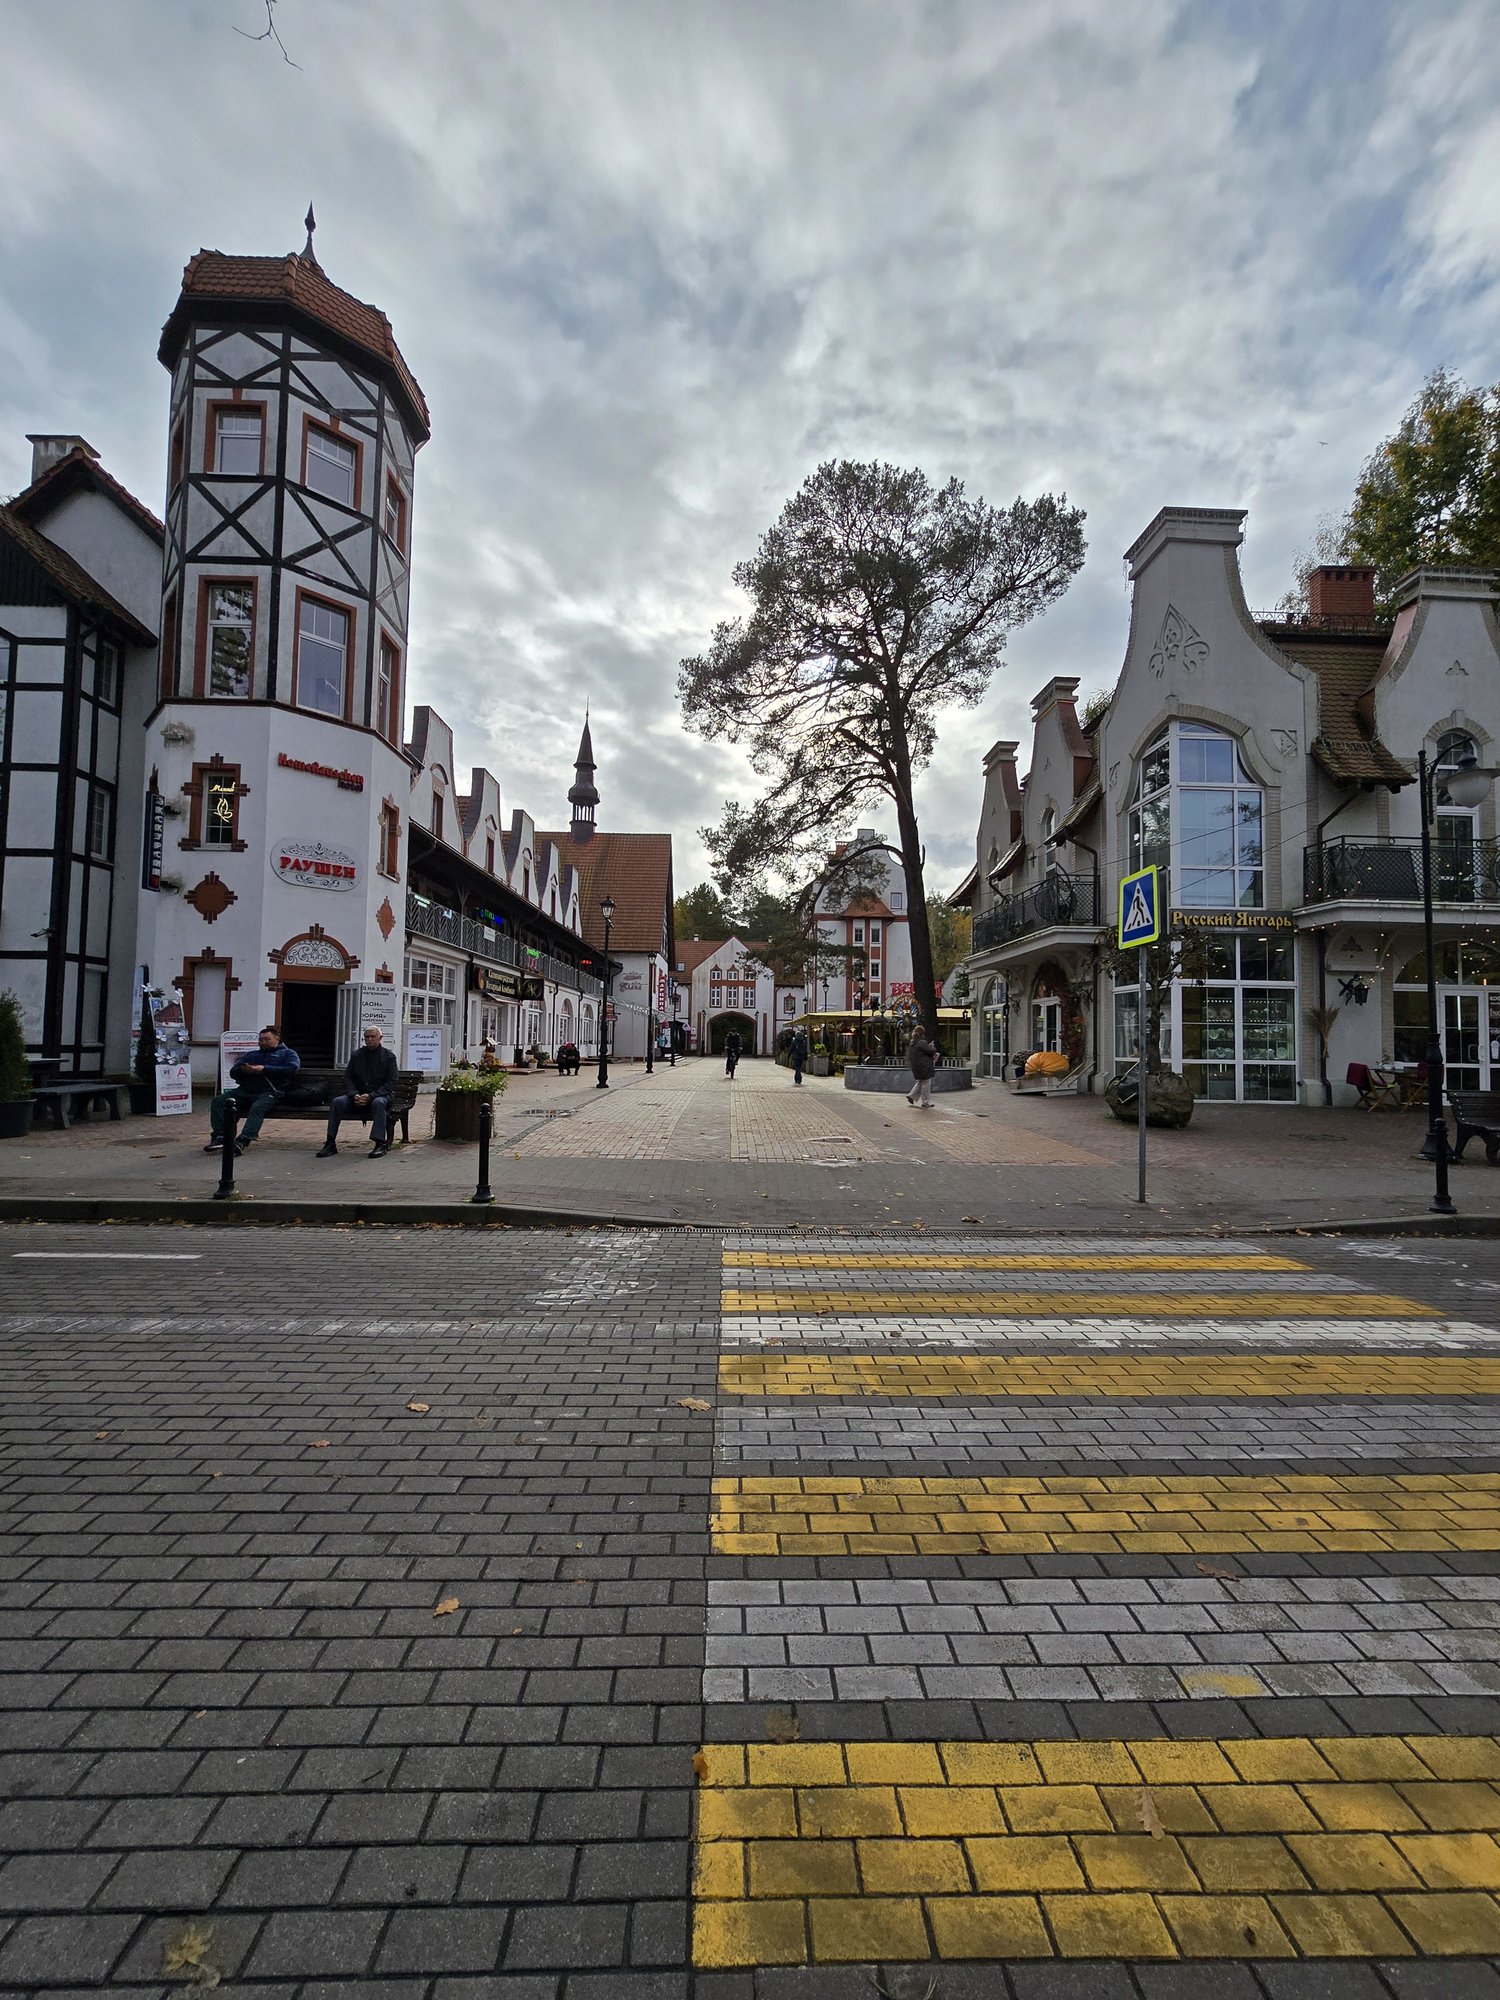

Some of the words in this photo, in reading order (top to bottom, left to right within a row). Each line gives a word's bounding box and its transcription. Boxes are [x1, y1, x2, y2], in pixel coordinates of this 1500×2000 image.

[337, 779, 363, 792] hotel
[152, 797, 164, 876] ЭКСКУРСИИ
[280, 856, 356, 879] РАУШЕН
[1172, 911, 1232, 927] Русский
[1236, 911, 1292, 930] Янтарь
[658, 977, 667, 1013] МАРЦИПА
